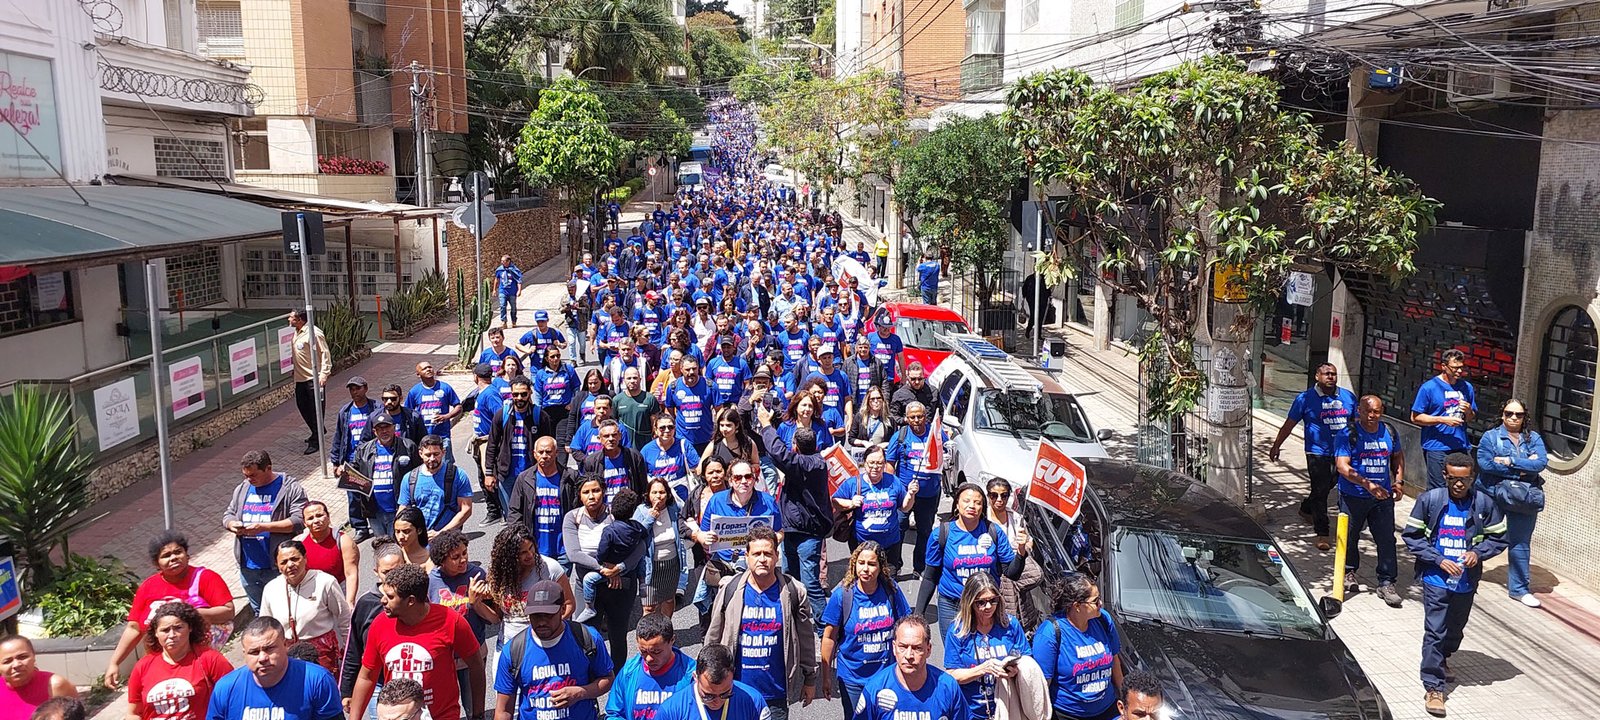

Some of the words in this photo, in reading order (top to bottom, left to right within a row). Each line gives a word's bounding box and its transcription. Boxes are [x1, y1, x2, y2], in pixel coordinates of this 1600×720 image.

[1035, 458, 1076, 494] CUT
[721, 522, 747, 531] Copasa
[742, 605, 764, 620] ÁGUA
[765, 607, 777, 619] DA
[858, 606, 878, 619] ÁGUA
[878, 604, 889, 617] DA
[854, 616, 894, 635] privada
[752, 634, 763, 647] DÁ
[764, 635, 778, 647] PRA
[872, 630, 882, 643] DÁ
[1076, 644, 1096, 659] ÁGUA
[1094, 641, 1106, 655] DA
[1072, 651, 1113, 677] privada
[532, 665, 558, 681] ÁGUA
[558, 663, 571, 676] DA
[1076, 673, 1090, 684] NÃO
[1091, 670, 1100, 681] DÁ
[636, 688, 660, 704] ÁGUA
[242, 706, 270, 720] ÁGUA
[270, 706, 285, 720] DA
[893, 709, 918, 720] ÁGUA
[918, 711, 931, 720] DA
